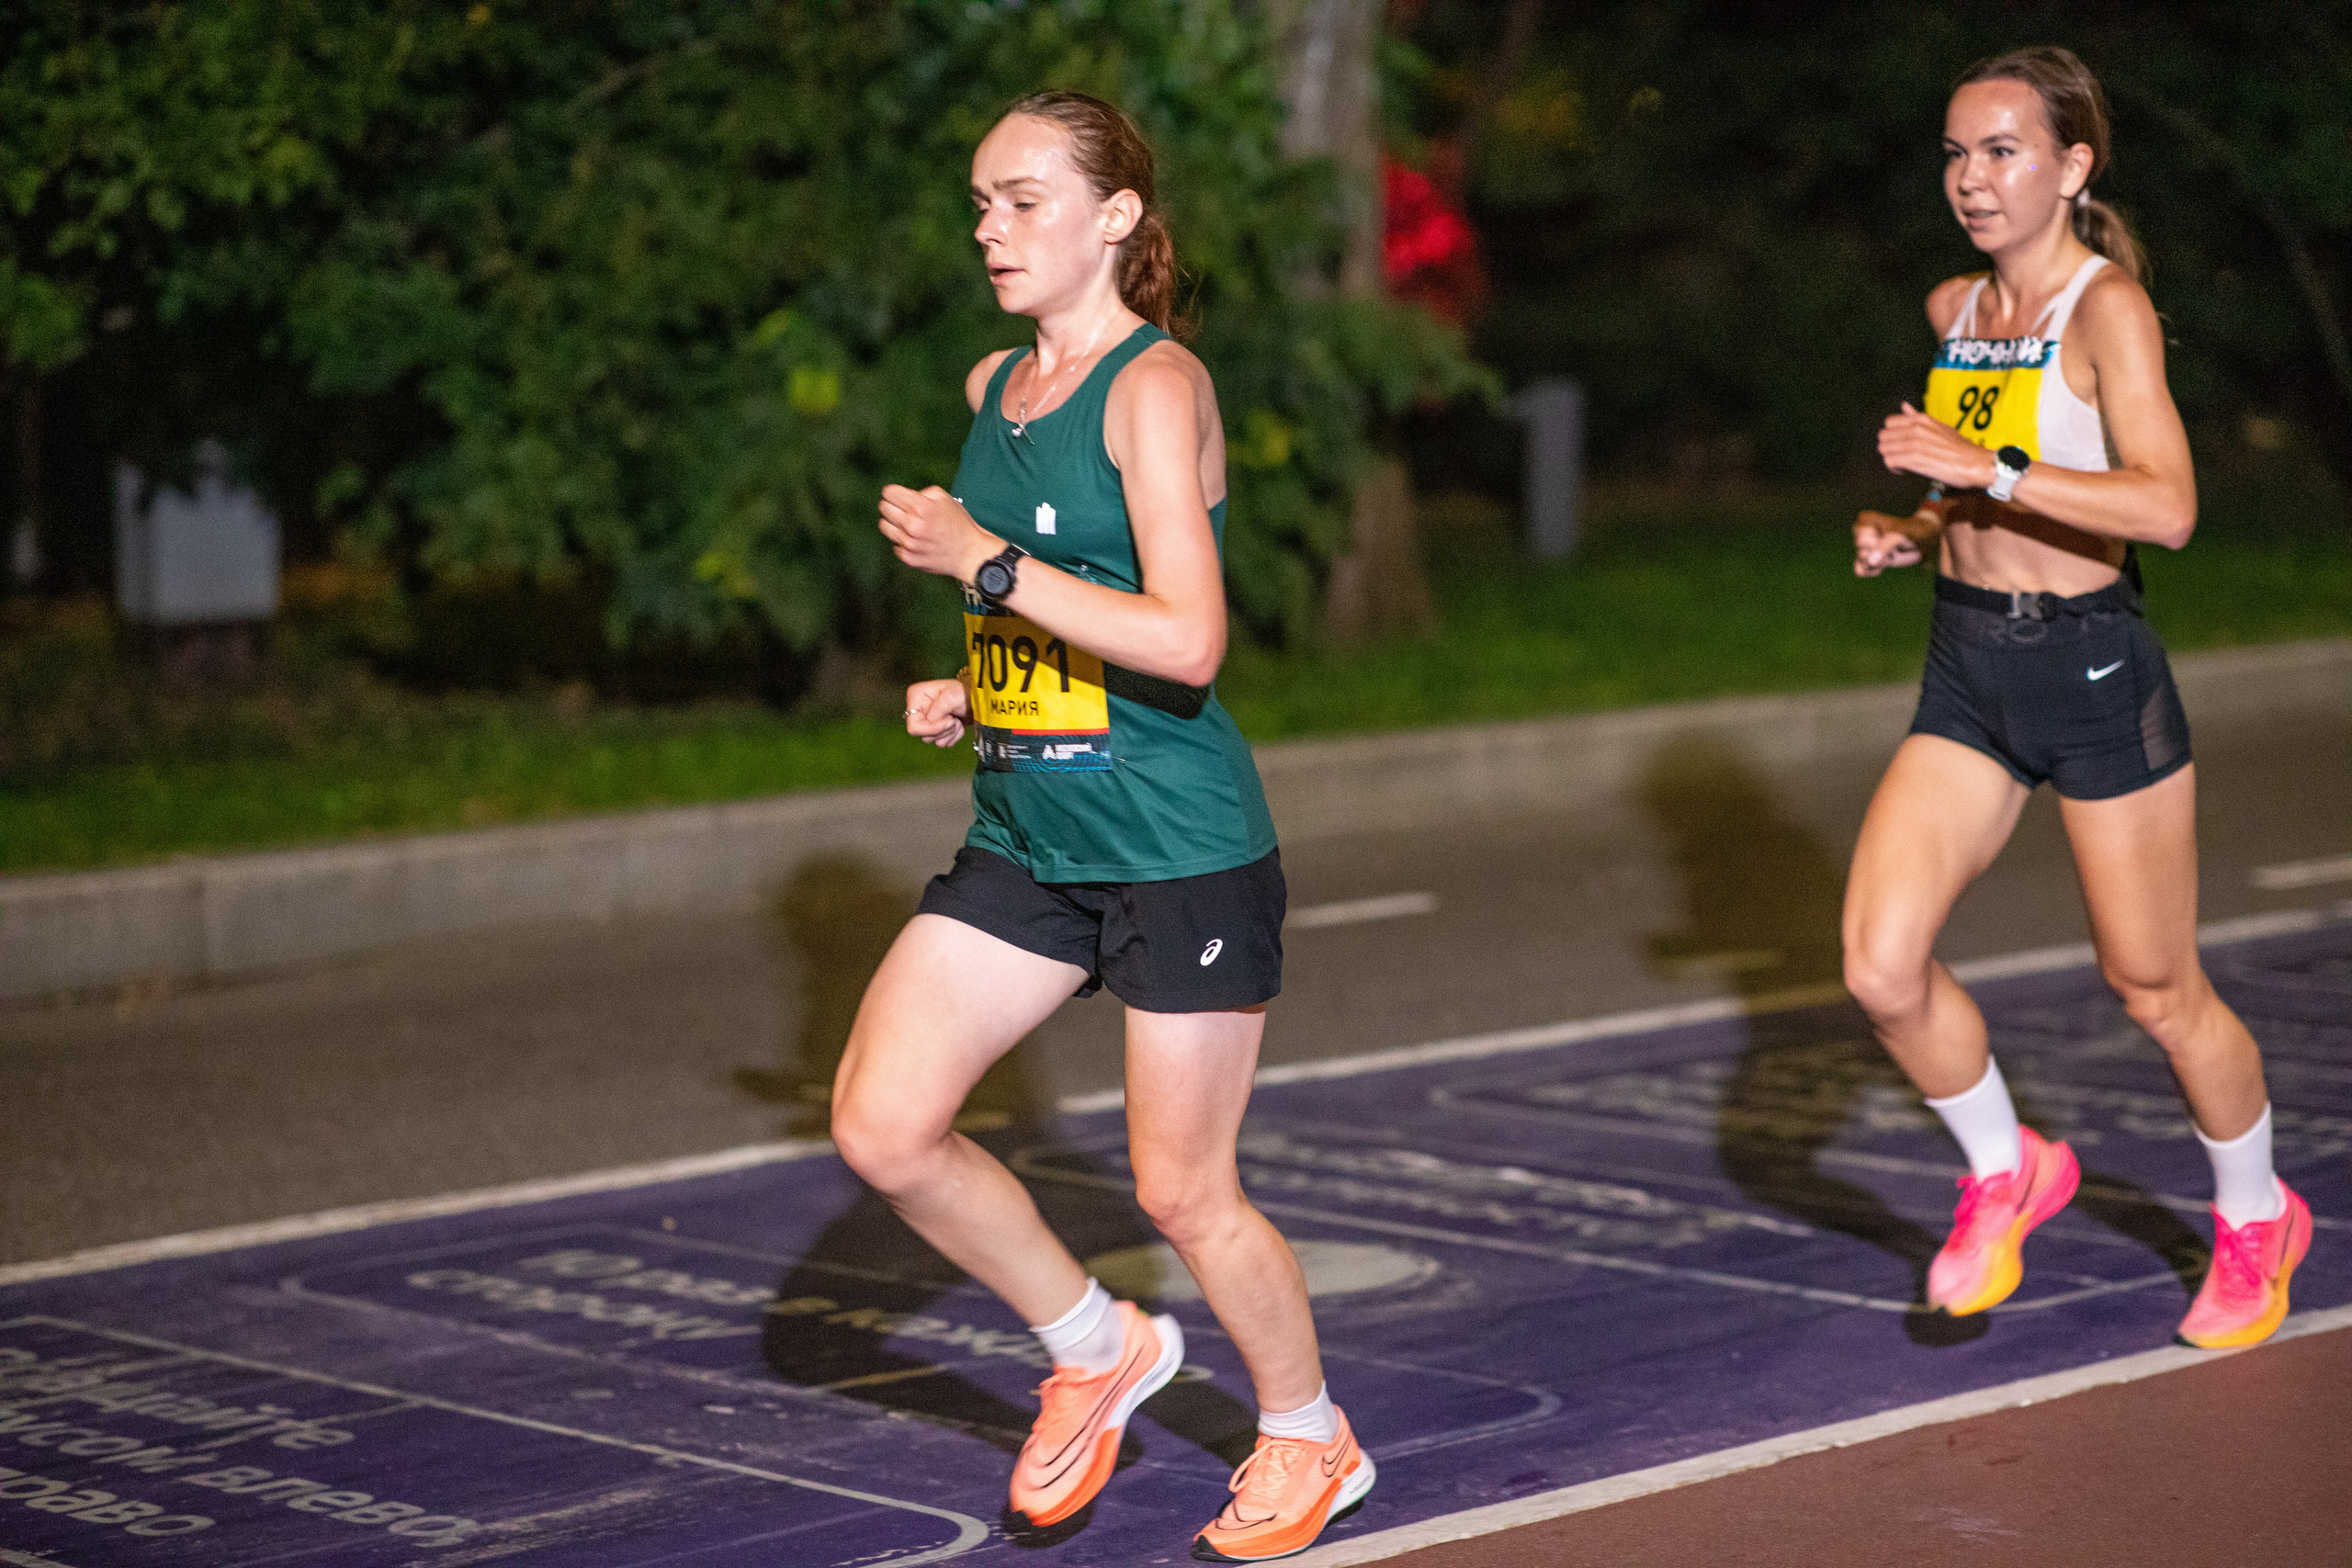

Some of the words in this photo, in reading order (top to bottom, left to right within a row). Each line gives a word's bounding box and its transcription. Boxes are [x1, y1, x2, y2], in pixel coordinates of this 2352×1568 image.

[1954, 386, 2000, 431] 98
[972, 632, 1069, 694] 7091
[990, 699, 1039, 716] МАРИЯ
[0, 1466, 216, 1536] раво
[180, 1465, 478, 1548] влево,
